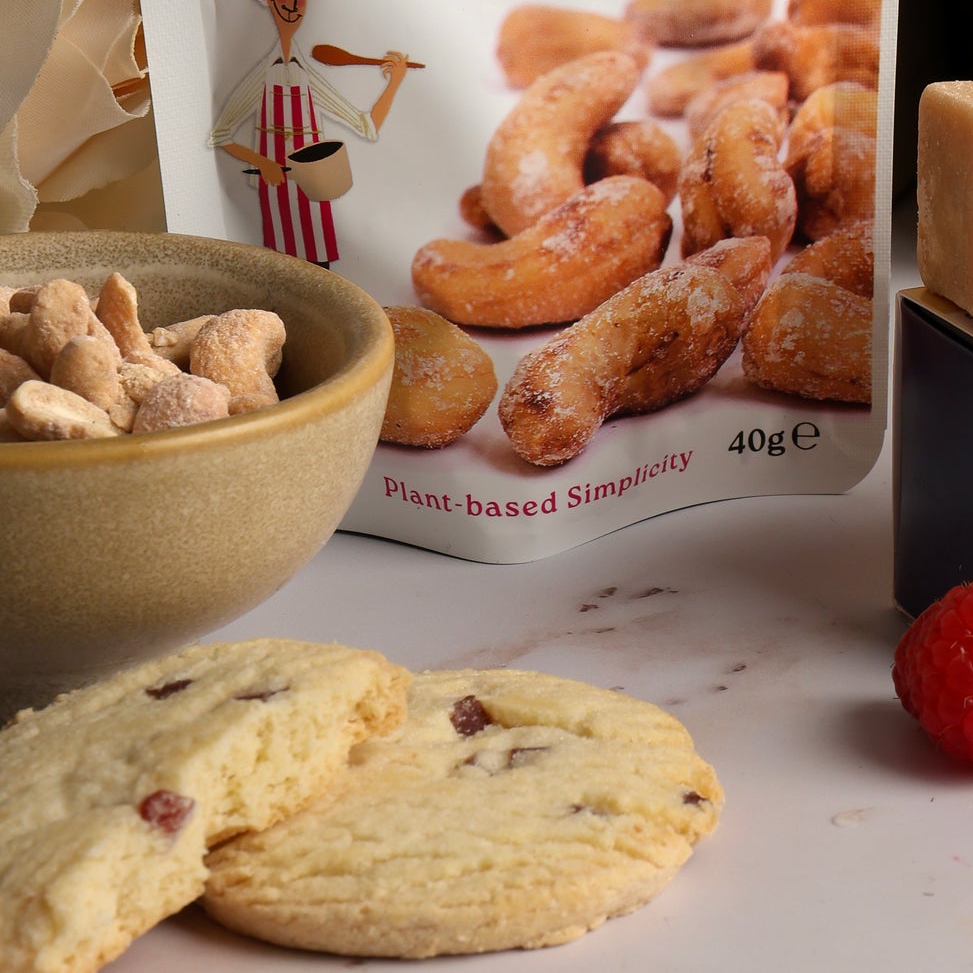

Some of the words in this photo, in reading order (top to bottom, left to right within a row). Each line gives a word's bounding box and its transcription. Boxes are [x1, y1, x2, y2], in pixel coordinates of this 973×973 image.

[728, 427, 786, 457] 40g
[383, 475, 558, 518] Plant-based
[566, 449, 695, 509] Simplicity
